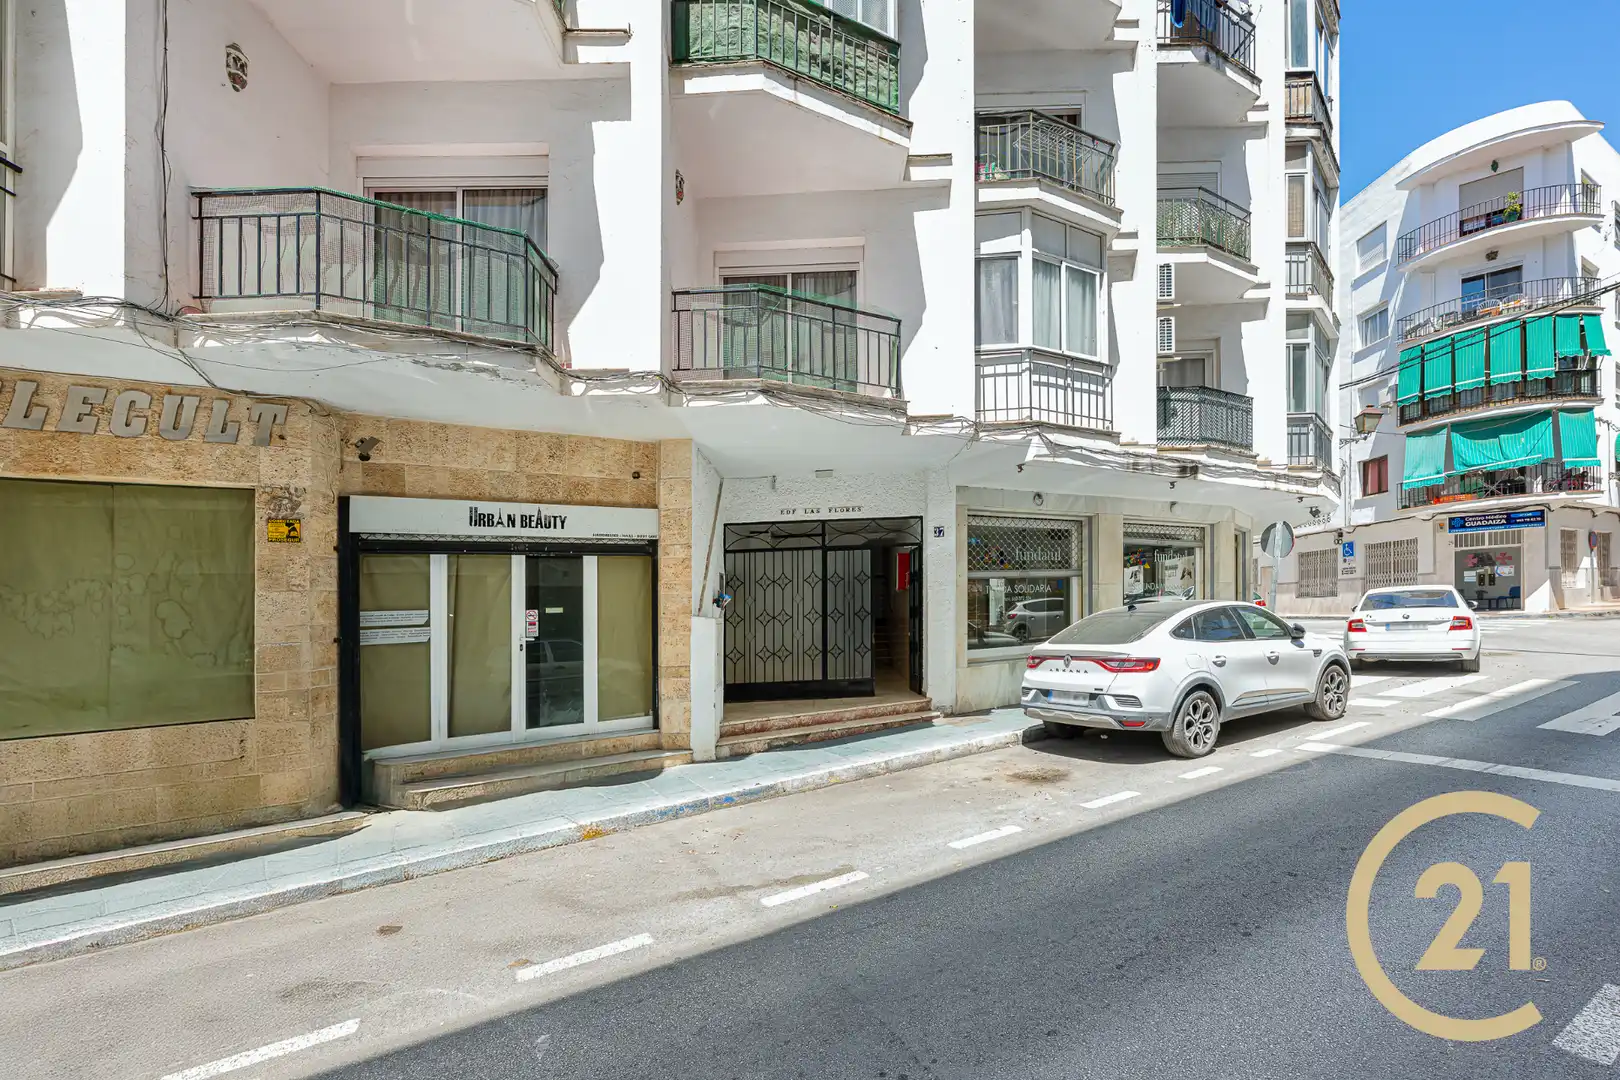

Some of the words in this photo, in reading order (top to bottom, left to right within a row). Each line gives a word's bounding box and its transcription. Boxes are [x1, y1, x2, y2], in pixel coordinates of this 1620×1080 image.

[0, 379, 289, 446] LECULT
[469, 506, 516, 528] URBAN
[520, 506, 568, 530] BEAUTY
[1465, 519, 1507, 527] GUADAIZA
[986, 585, 1013, 594] TDA
[1014, 583, 1052, 594] SOLIDARIA
